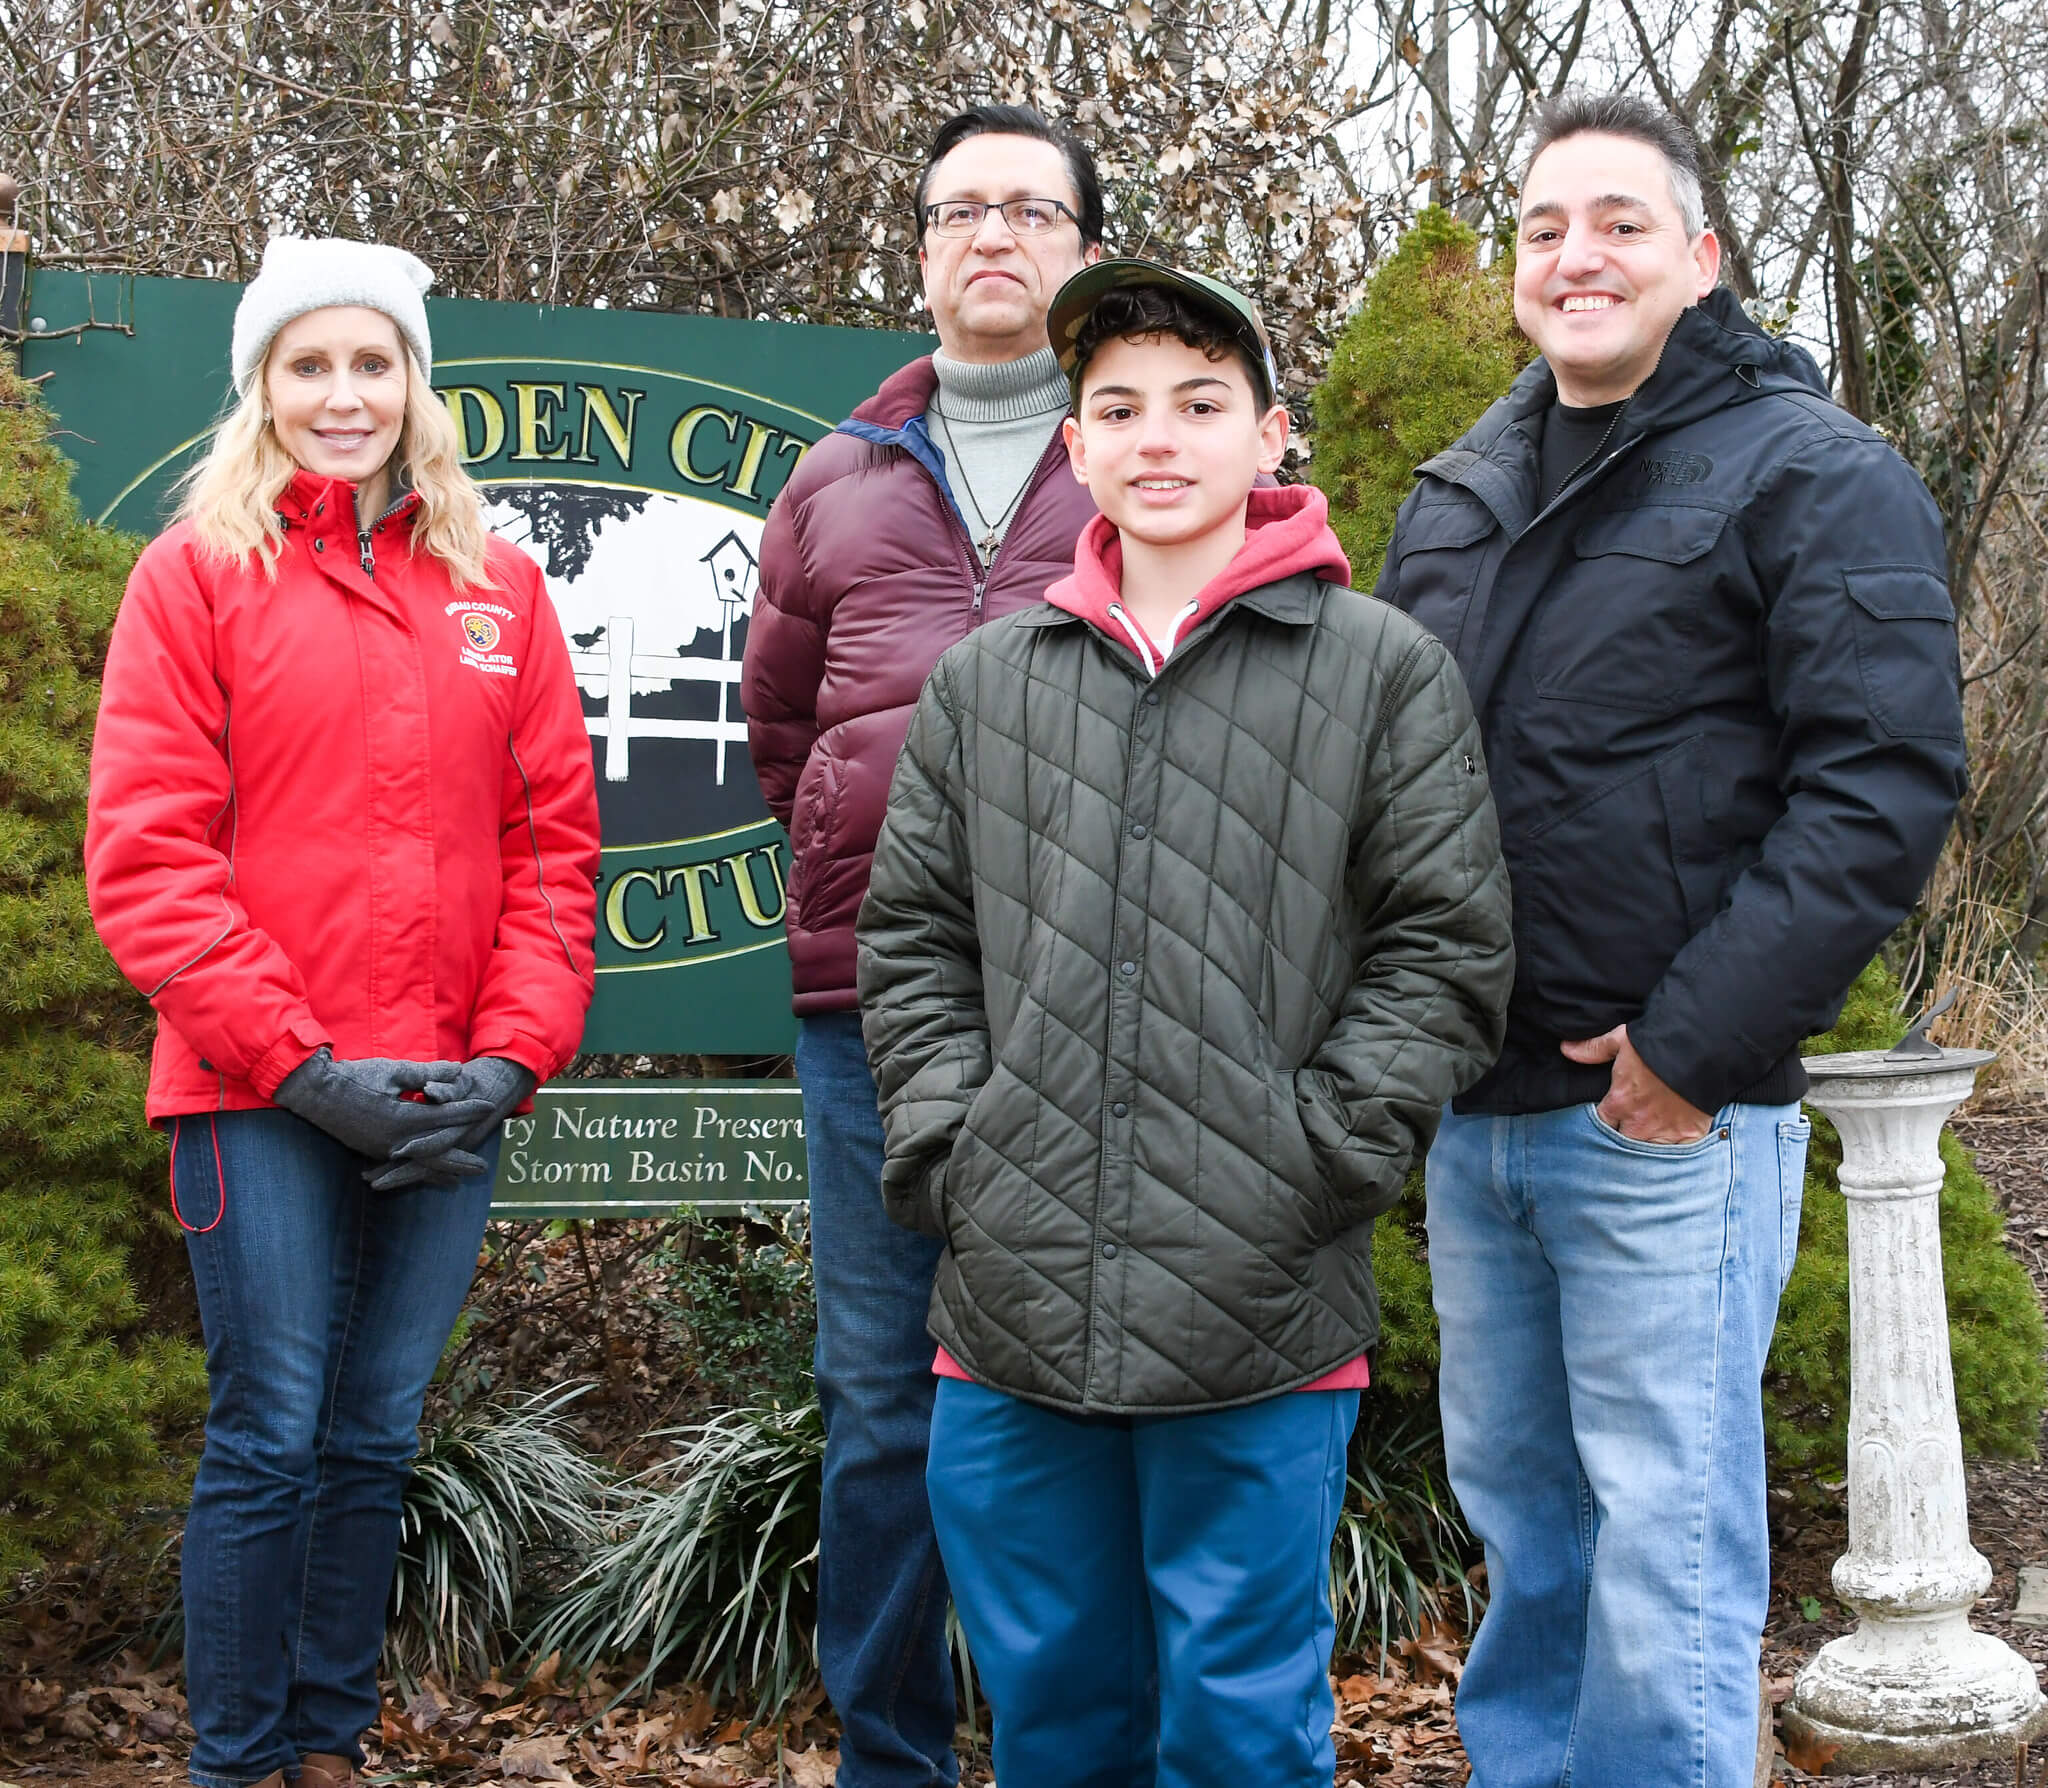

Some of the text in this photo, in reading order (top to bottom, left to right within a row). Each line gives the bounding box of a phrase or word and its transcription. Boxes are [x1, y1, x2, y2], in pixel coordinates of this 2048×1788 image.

[471, 602, 516, 621] COUNTY
[594, 840, 787, 951] CTU
[551, 1106, 678, 1140] Nature
[506, 1150, 804, 1184] Storm Basin No.
